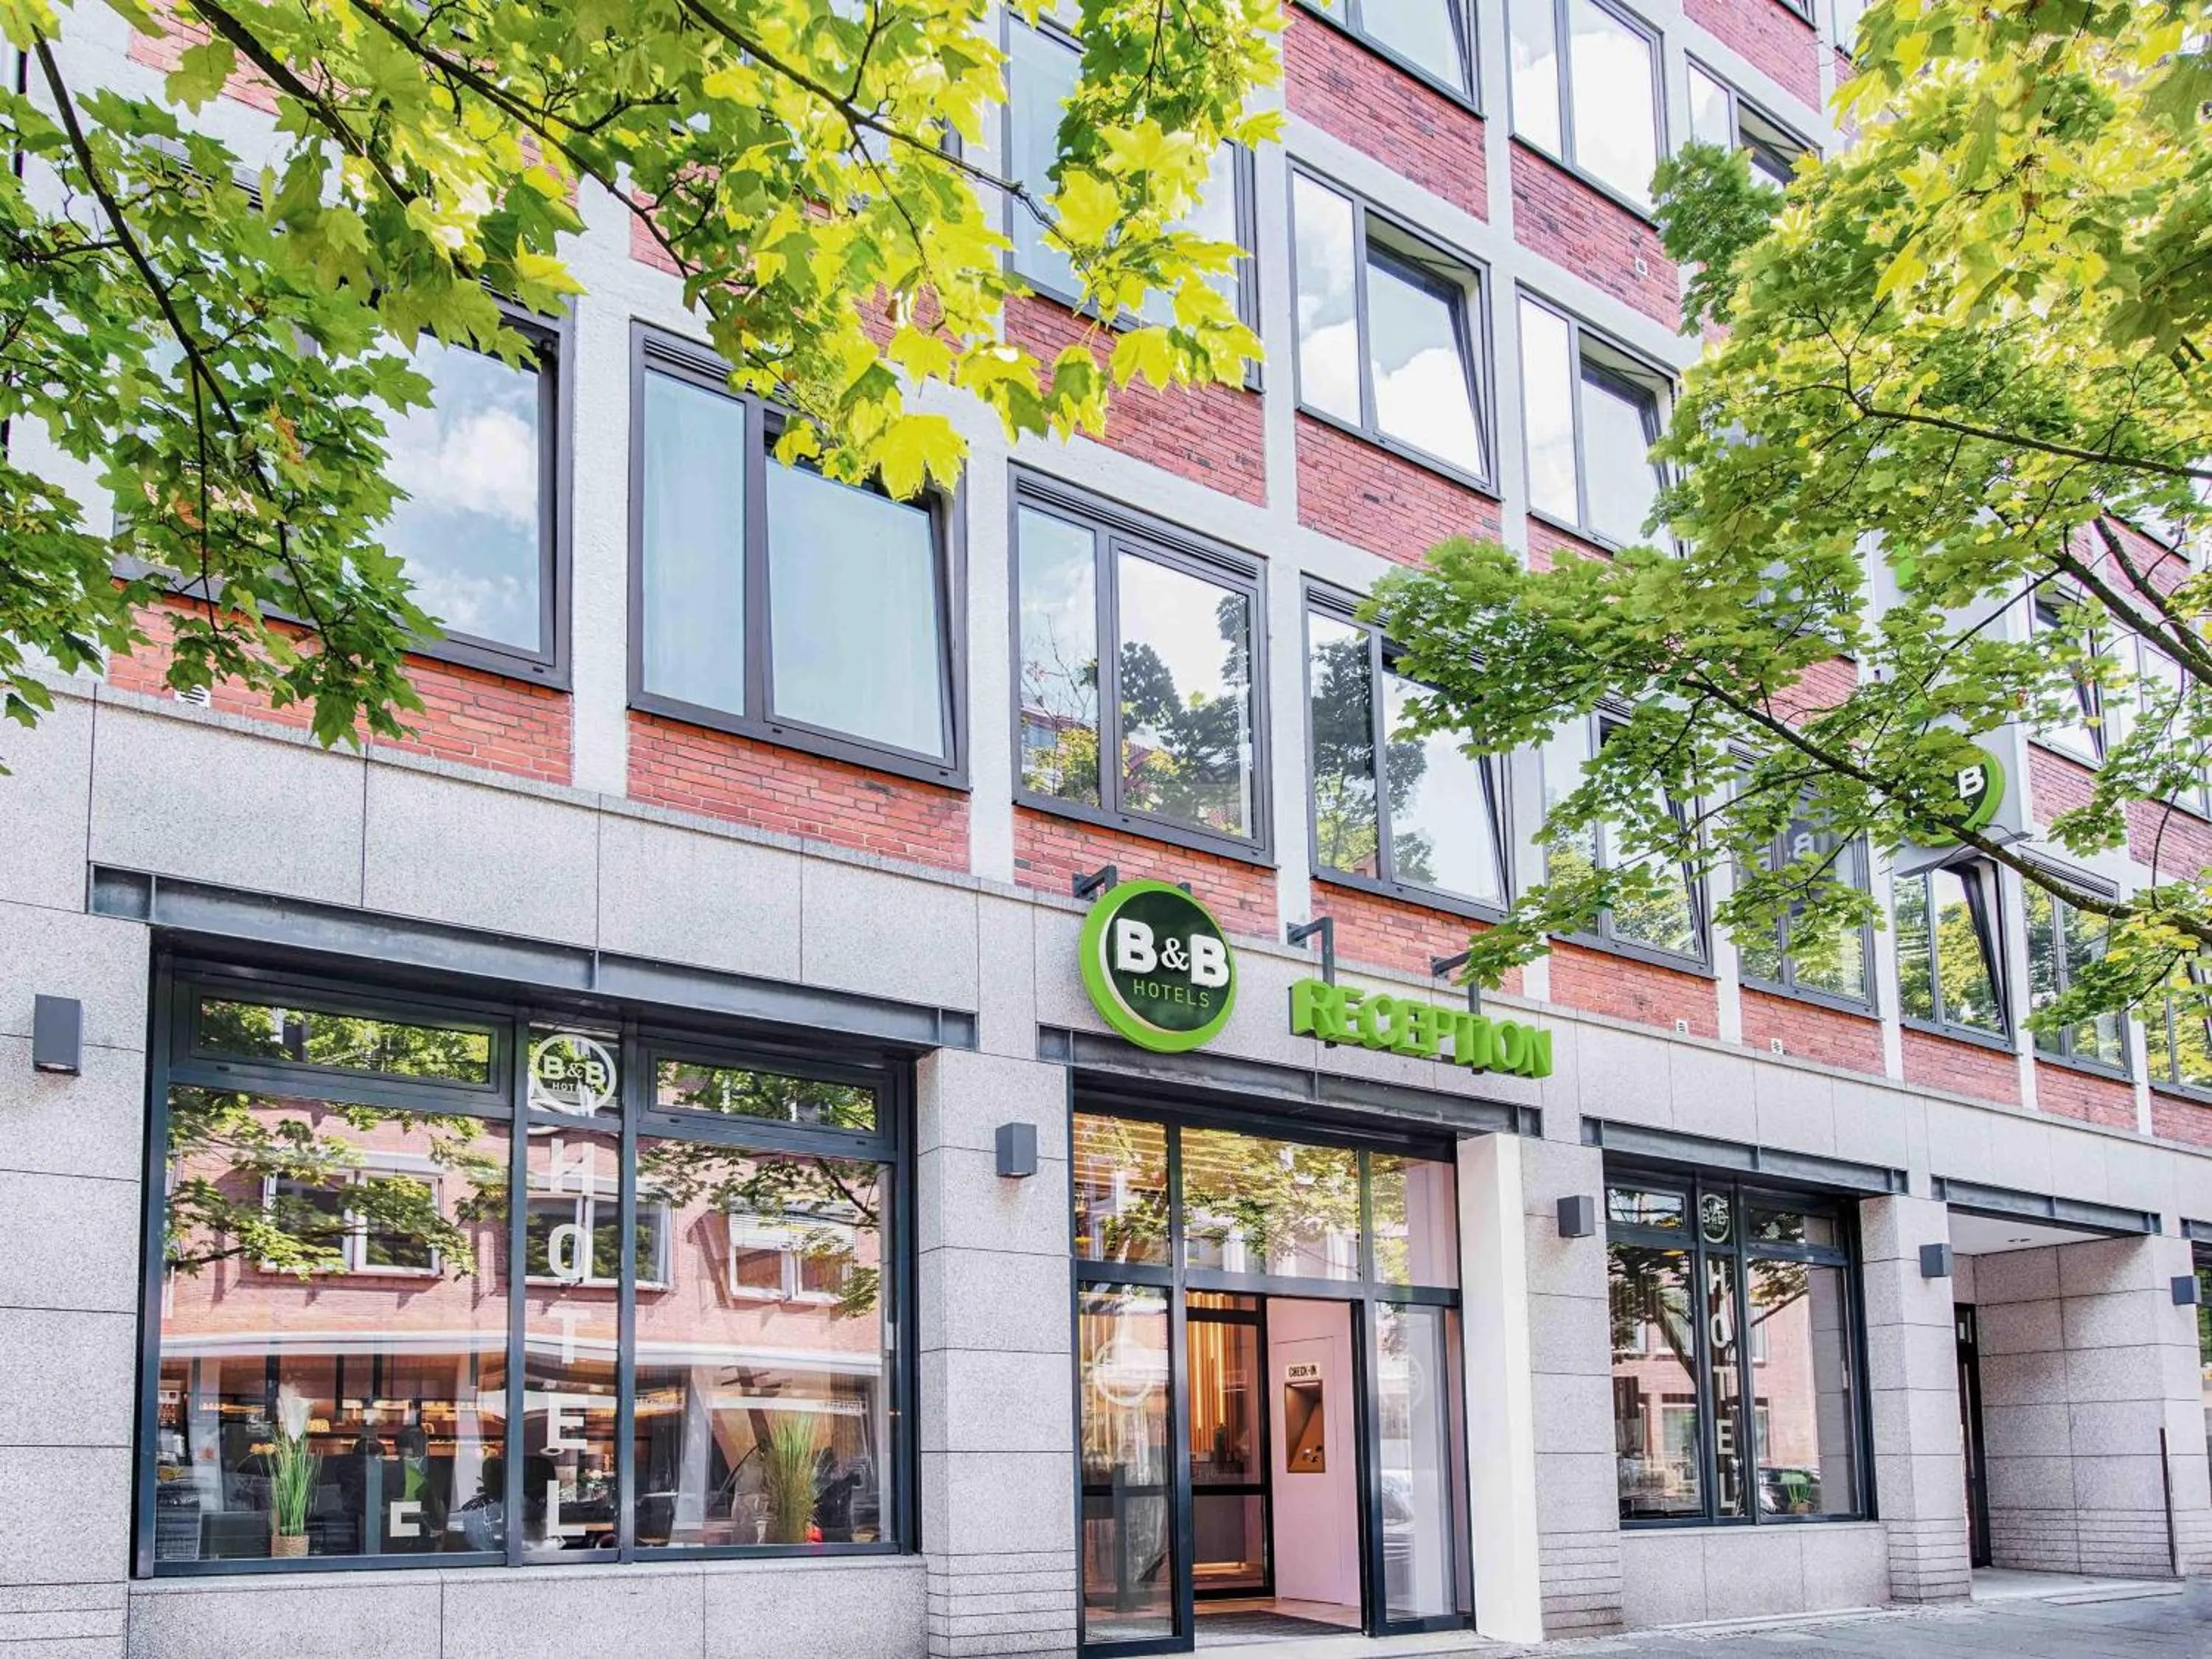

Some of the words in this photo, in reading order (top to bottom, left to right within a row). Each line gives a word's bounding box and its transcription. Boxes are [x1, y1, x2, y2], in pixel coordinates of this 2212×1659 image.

[1115, 918, 1230, 988] B&B
[1133, 978, 1210, 1008] HOTELS
[543, 1054, 606, 1085] B&B
[1290, 978, 1552, 1078] RECEPTION
[547, 1138, 595, 1537] HOTEL
[1707, 1259, 1737, 1509] HOTEL
